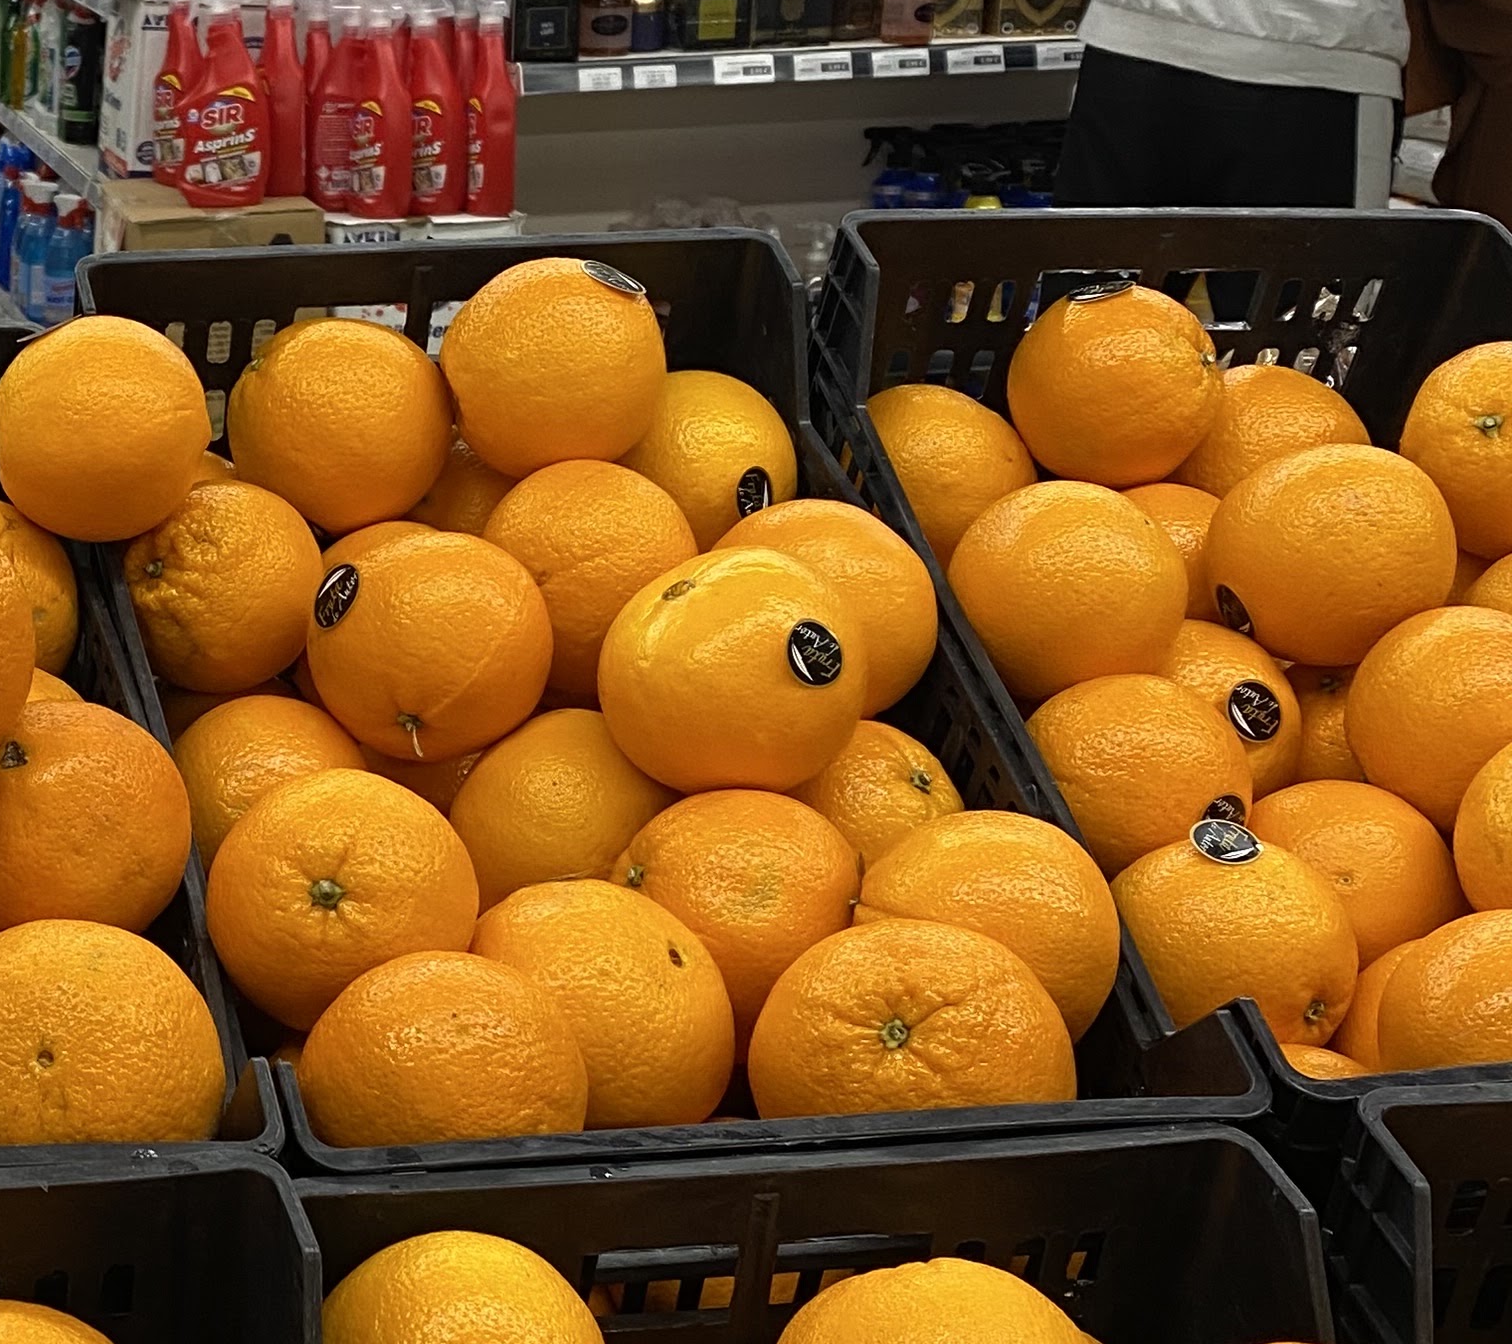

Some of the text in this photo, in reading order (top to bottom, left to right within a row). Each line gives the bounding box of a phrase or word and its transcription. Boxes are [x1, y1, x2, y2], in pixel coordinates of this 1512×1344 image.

[795, 624, 827, 651] Autor
[801, 644, 841, 679] Fruta
[1236, 684, 1267, 707] Autor
[1242, 703, 1279, 735] Fruta
